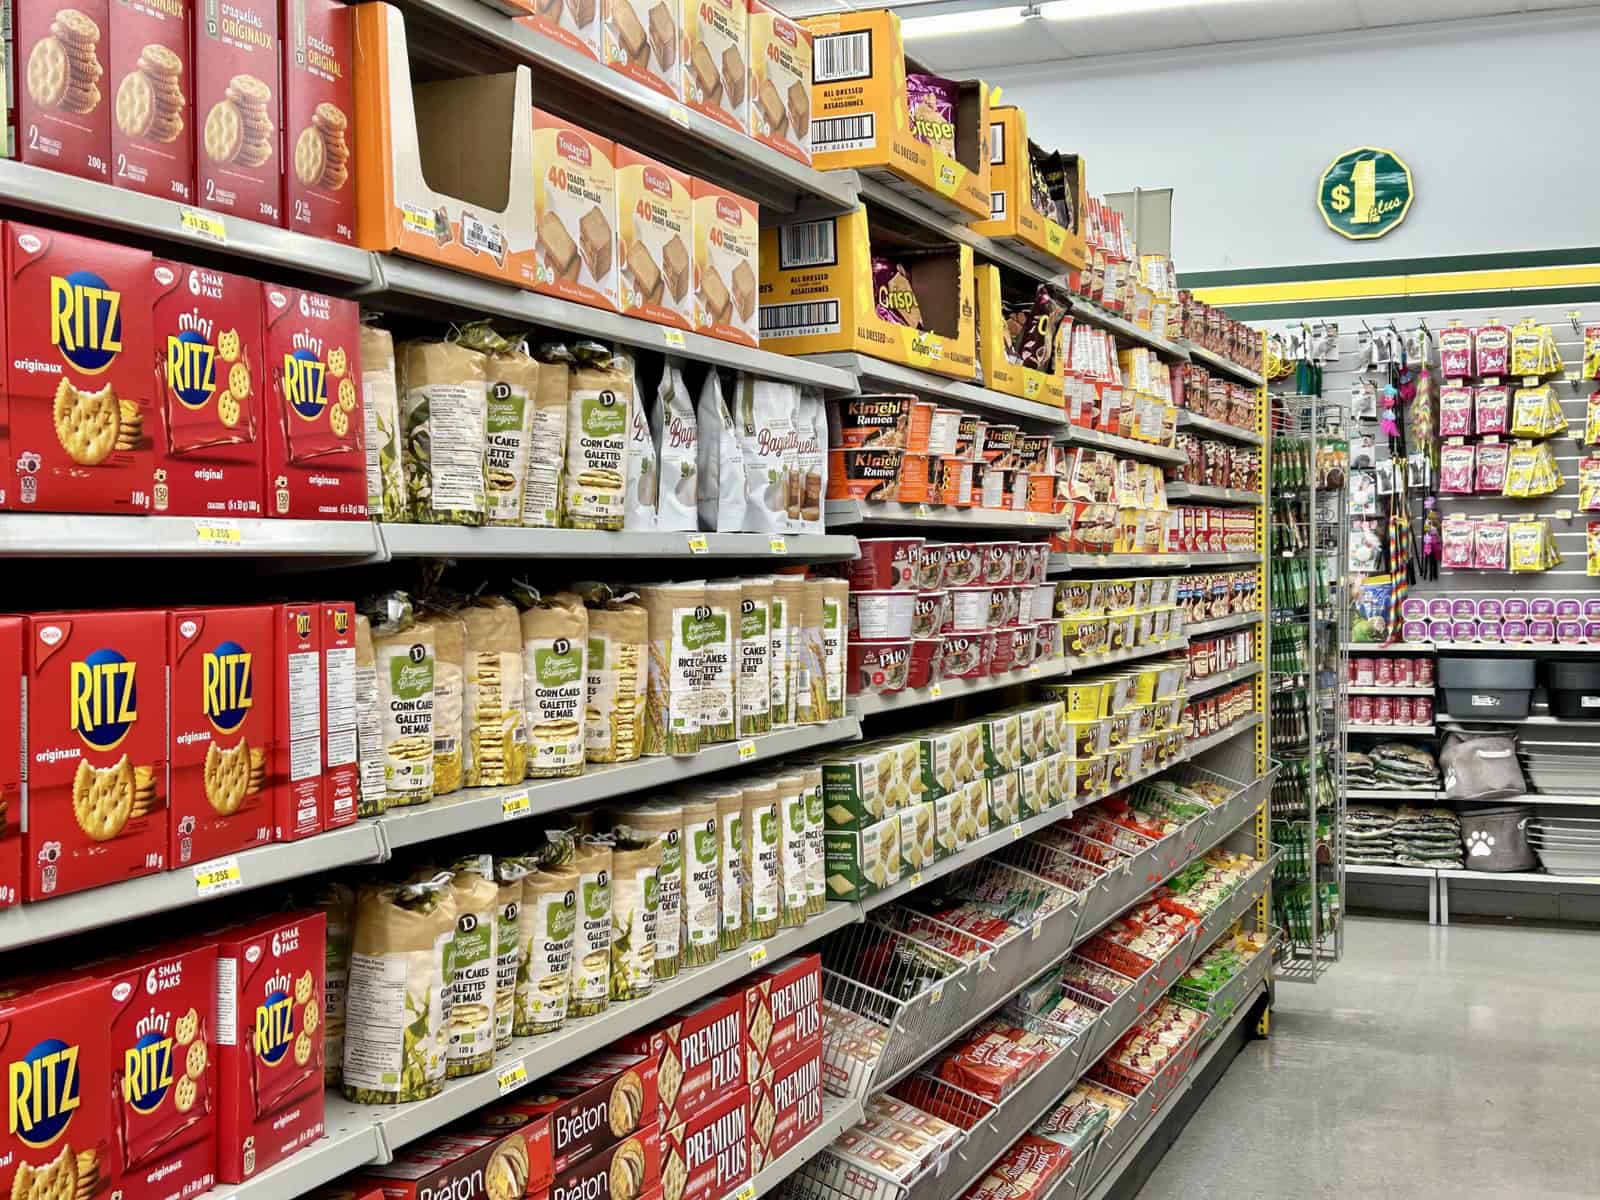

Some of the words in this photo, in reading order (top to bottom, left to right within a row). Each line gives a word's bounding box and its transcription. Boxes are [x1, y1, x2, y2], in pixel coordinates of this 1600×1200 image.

[222, 18, 273, 50] ORIGINAUX
[823, 89, 835, 98] ALL
[30, 128, 39, 149] 2
[118, 154, 127, 177] 2
[548, 165, 567, 191] 40
[206, 179, 216, 201] 2
[295, 200, 303, 219] 2
[636, 199, 651, 221] 40
[709, 227, 723, 247] 40
[188, 270, 201, 296] 6
[201, 273, 223, 287] SNAK
[201, 285, 223, 299] PAKS
[878, 284, 920, 313] Crisp
[51, 275, 122, 353] RITZ
[299, 294, 309, 318] 6
[311, 307, 330, 320] PAKS
[178, 307, 213, 340] mini
[292, 328, 323, 357] mini
[14, 358, 63, 374] originaux
[168, 335, 216, 392] RITZ
[284, 353, 328, 405] RITZ
[848, 400, 901, 418] Kimchi
[857, 415, 894, 426] Ramen
[497, 437, 520, 448] CAKES
[580, 438, 603, 449] CORN
[604, 439, 625, 450] CAKES
[487, 448, 515, 460] LETTES
[585, 450, 621, 461] GALETTES
[589, 460, 599, 469] DE
[195, 468, 223, 481] original
[309, 474, 340, 487] originaux
[863, 467, 895, 478] Ramen
[296, 612, 311, 634] RITZ
[334, 609, 348, 630] RITZ
[743, 646, 766, 656] CAKES
[880, 648, 906, 668] PHO
[678, 657, 694, 668] RICE
[203, 652, 252, 716] RITZ
[535, 687, 558, 698] CORN
[559, 687, 580, 698] CAKES
[71, 661, 137, 732] RITZ
[391, 701, 414, 711] CORN
[539, 699, 577, 710] GALETTES
[395, 713, 431, 725] GALETTES
[543, 710, 555, 719] DE
[177, 731, 211, 745] originaux
[400, 726, 411, 735] DE
[36, 746, 81, 763] originaux
[272, 933, 281, 957] 6
[281, 927, 299, 942] SNAK
[281, 939, 299, 954] PAKS
[159, 961, 182, 977] SNAK
[465, 968, 489, 979] CAKES
[145, 968, 158, 996] 6
[159, 973, 181, 989] PAKS
[264, 968, 292, 997] mini
[771, 970, 818, 1024] PREMIUM
[136, 1007, 171, 1037] mini
[256, 996, 294, 1056] RITZ
[796, 1001, 820, 1042] PLUS
[681, 1010, 741, 1073] PREMIUM
[125, 1037, 173, 1103] RITZ
[711, 1047, 741, 1091] PLUS
[9, 1045, 80, 1135] RITZ
[774, 1055, 820, 1114] PREMIUM
[797, 1086, 820, 1130] PLUS
[557, 1101, 608, 1150] Breton
[685, 1104, 746, 1173] PREMIUM
[147, 1160, 182, 1183] originaux
[716, 1140, 747, 1188] PLUS
